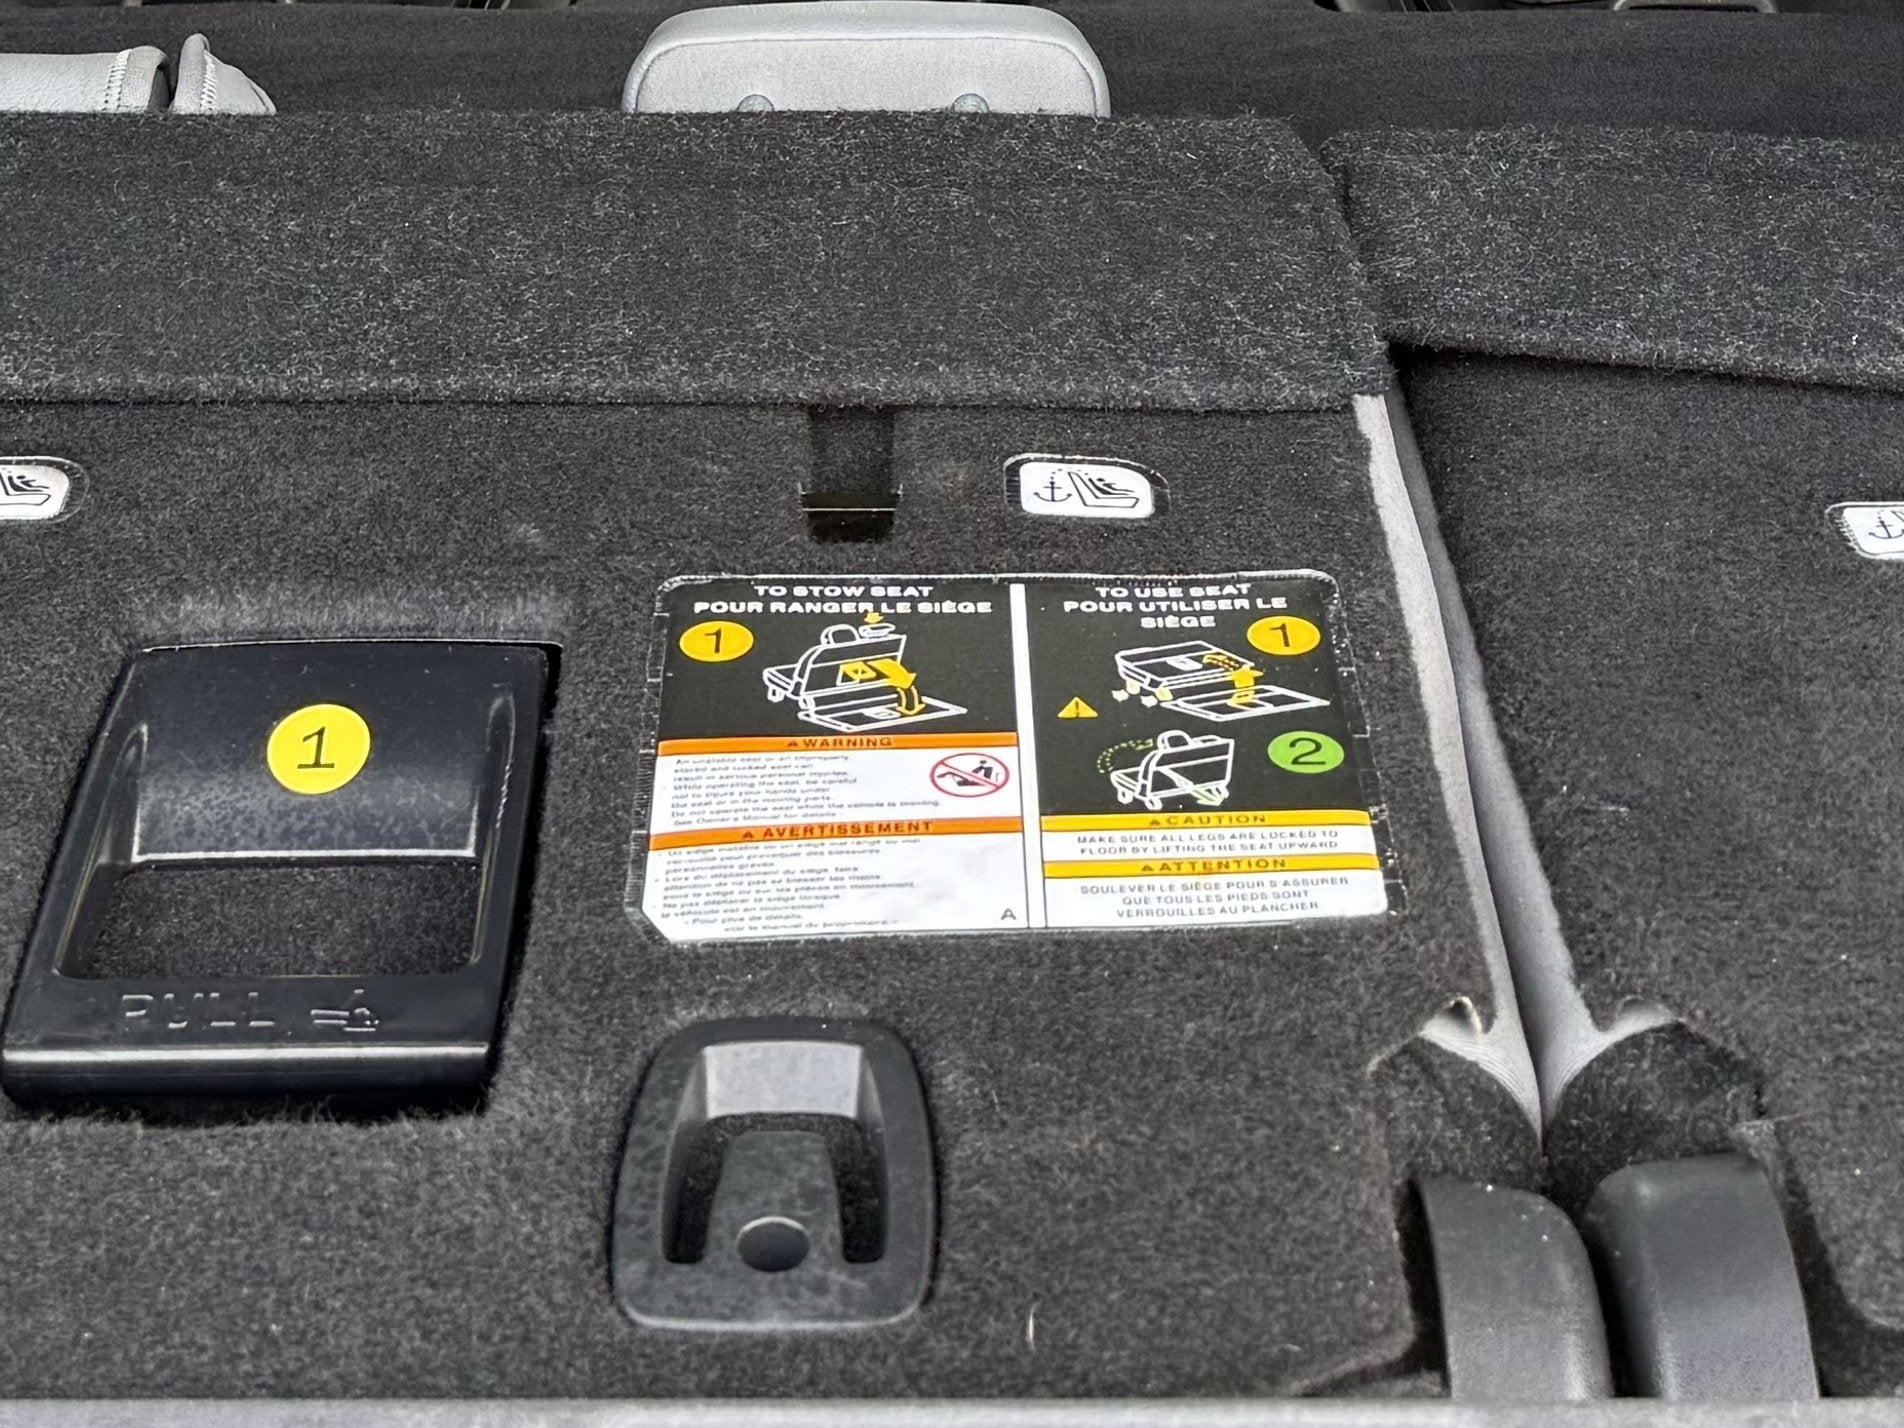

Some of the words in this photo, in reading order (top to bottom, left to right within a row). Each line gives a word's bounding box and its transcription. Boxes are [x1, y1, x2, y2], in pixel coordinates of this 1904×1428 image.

[753, 585, 788, 597] TO
[792, 585, 866, 597] STOW
[870, 586, 934, 598] SEAT
[1095, 586, 1129, 598] TO
[1134, 586, 1184, 598] USE
[1189, 583, 1252, 597] SEAT
[693, 601, 765, 614] POUR
[769, 601, 875, 614] RANGER
[881, 601, 912, 614] LE
[1063, 600, 1134, 612] POUR
[1139, 598, 1251, 612] UTILISER
[1256, 597, 1288, 609] LE
[704, 628, 723, 654] 1
[1269, 622, 1291, 648] 1
[296, 725, 336, 770] 1
[802, 737, 893, 748] WARNING
[1288, 737, 1327, 766] 2
[1166, 815, 1266, 826] CAUTION
[762, 821, 932, 839] AVERTISSEMENT
[1161, 834, 1185, 842] ALL
[1321, 830, 1338, 838] TO
[1159, 859, 1287, 871] ATTENTION
[1080, 884, 1156, 894] SOULEVER
[1160, 883, 1176, 892] LE
[1227, 881, 1266, 890] POUR
[1122, 896, 1152, 905] QUE
[1157, 895, 1193, 904] TOUS
[1197, 894, 1223, 903] LES
[1228, 893, 1268, 902] PIEDS
[1000, 907, 1017, 921] A
[1220, 905, 1237, 914] AU
